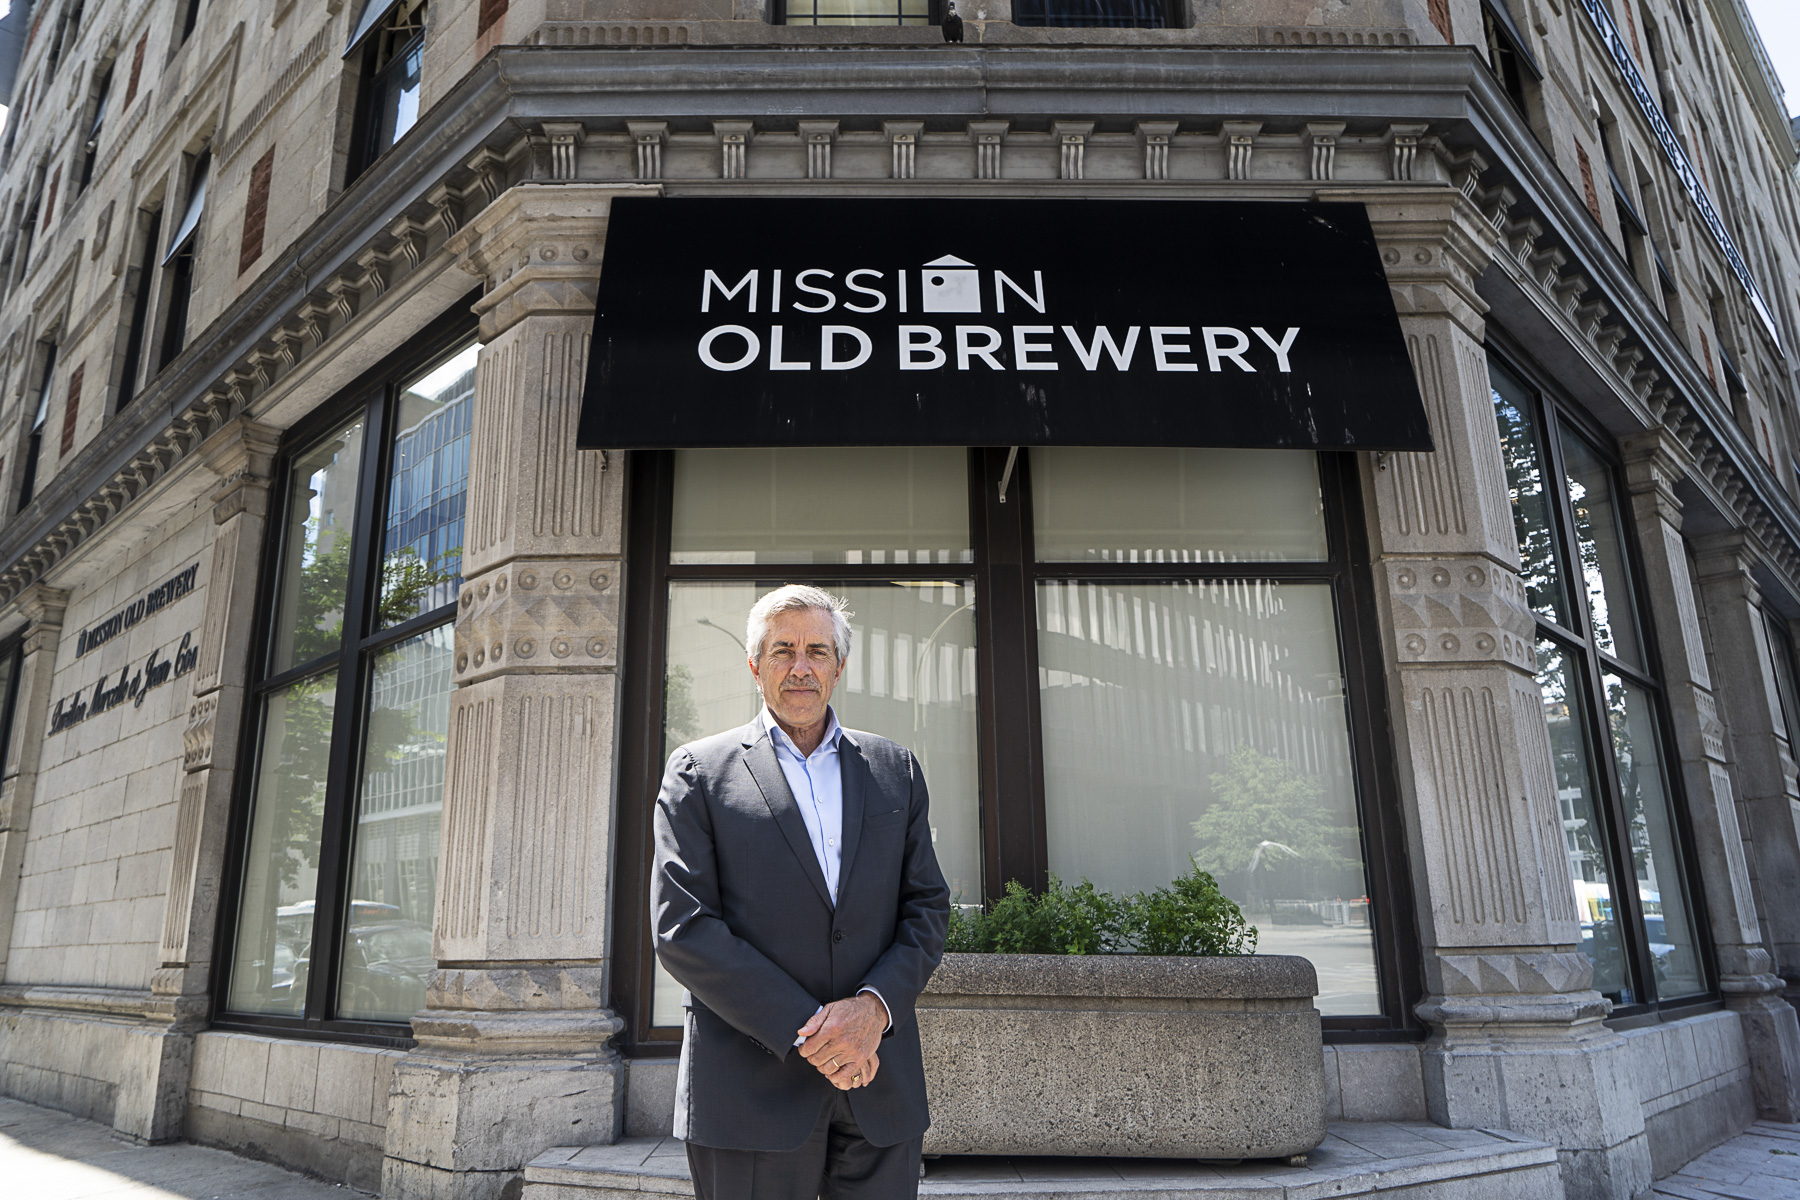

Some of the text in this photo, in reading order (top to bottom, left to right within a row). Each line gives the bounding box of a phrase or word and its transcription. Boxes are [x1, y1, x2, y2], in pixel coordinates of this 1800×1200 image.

[698, 324, 1301, 373] OLD BREWERY
[85, 561, 199, 653] MISSION OLD BREWERY
